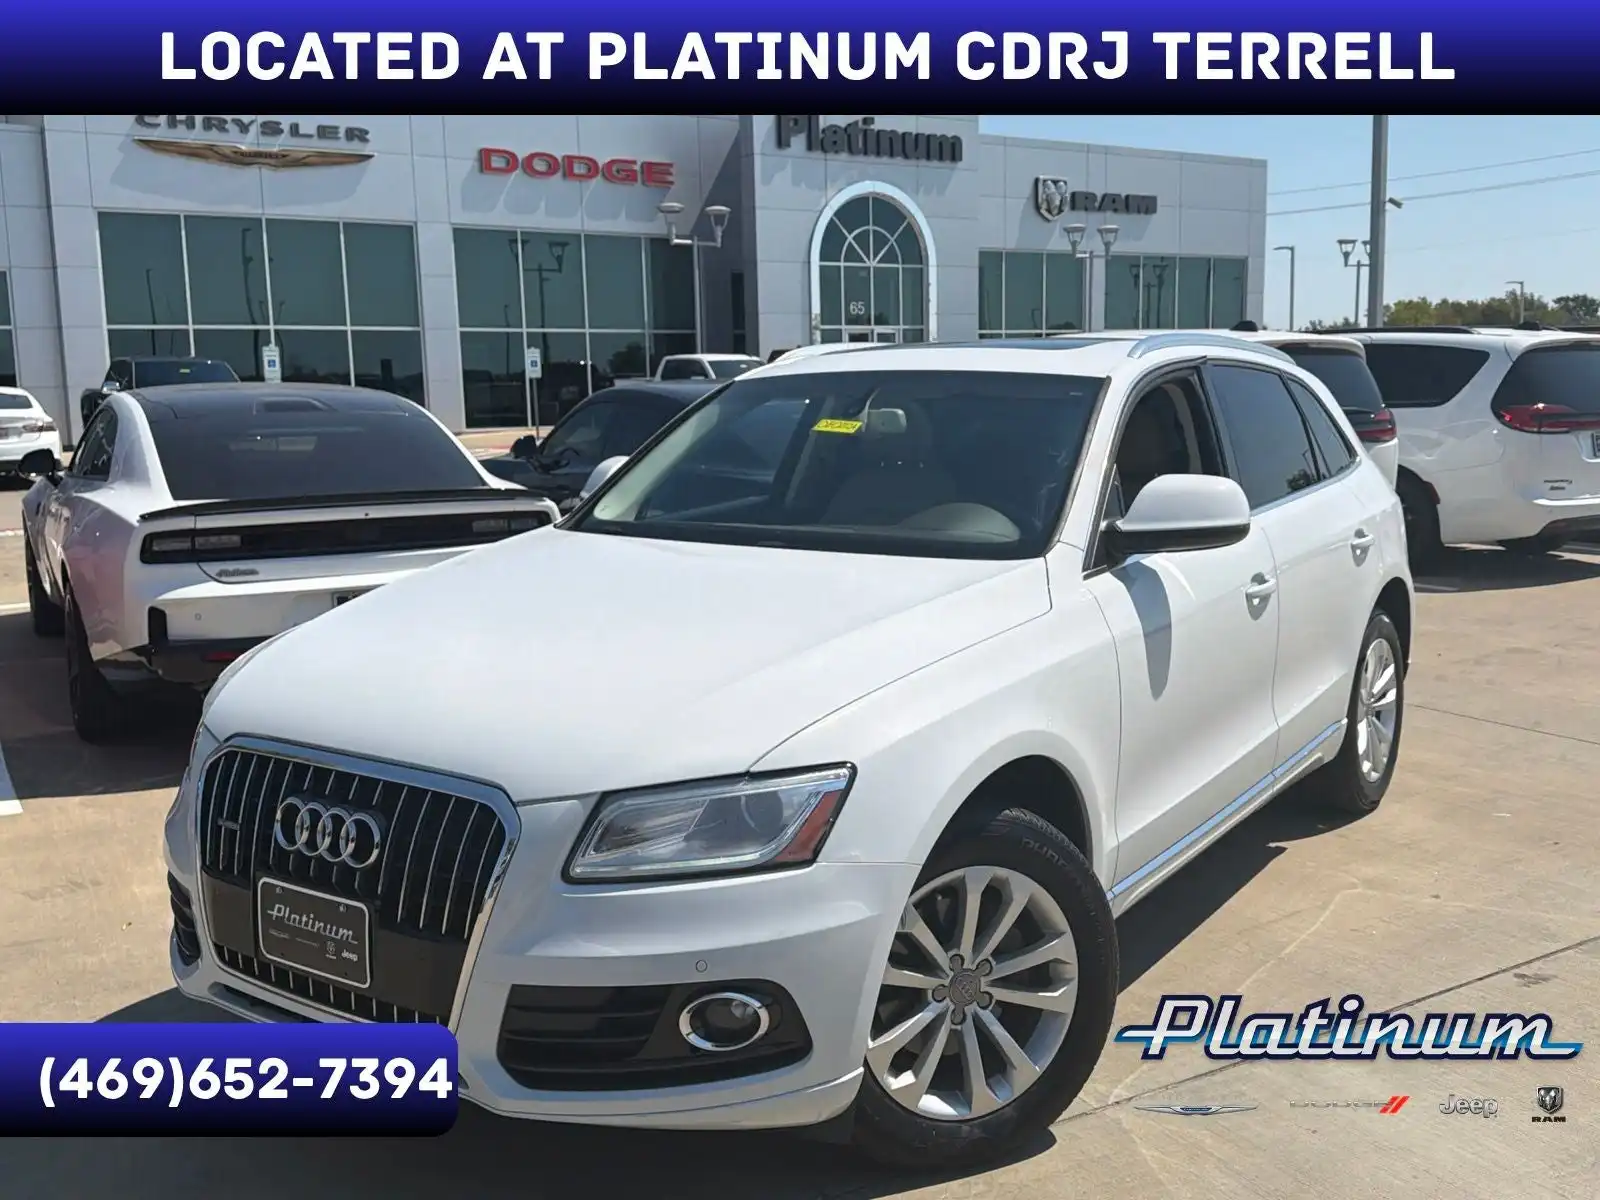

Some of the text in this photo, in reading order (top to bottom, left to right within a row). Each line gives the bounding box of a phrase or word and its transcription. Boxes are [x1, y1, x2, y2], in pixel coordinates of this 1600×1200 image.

[134, 114, 371, 143] CHRYSLER
[776, 114, 964, 163] Platinum
[479, 147, 675, 187] DODGE
[1070, 190, 1158, 216] RAM
[849, 301, 865, 316] 65
[267, 903, 358, 945] Platinum
